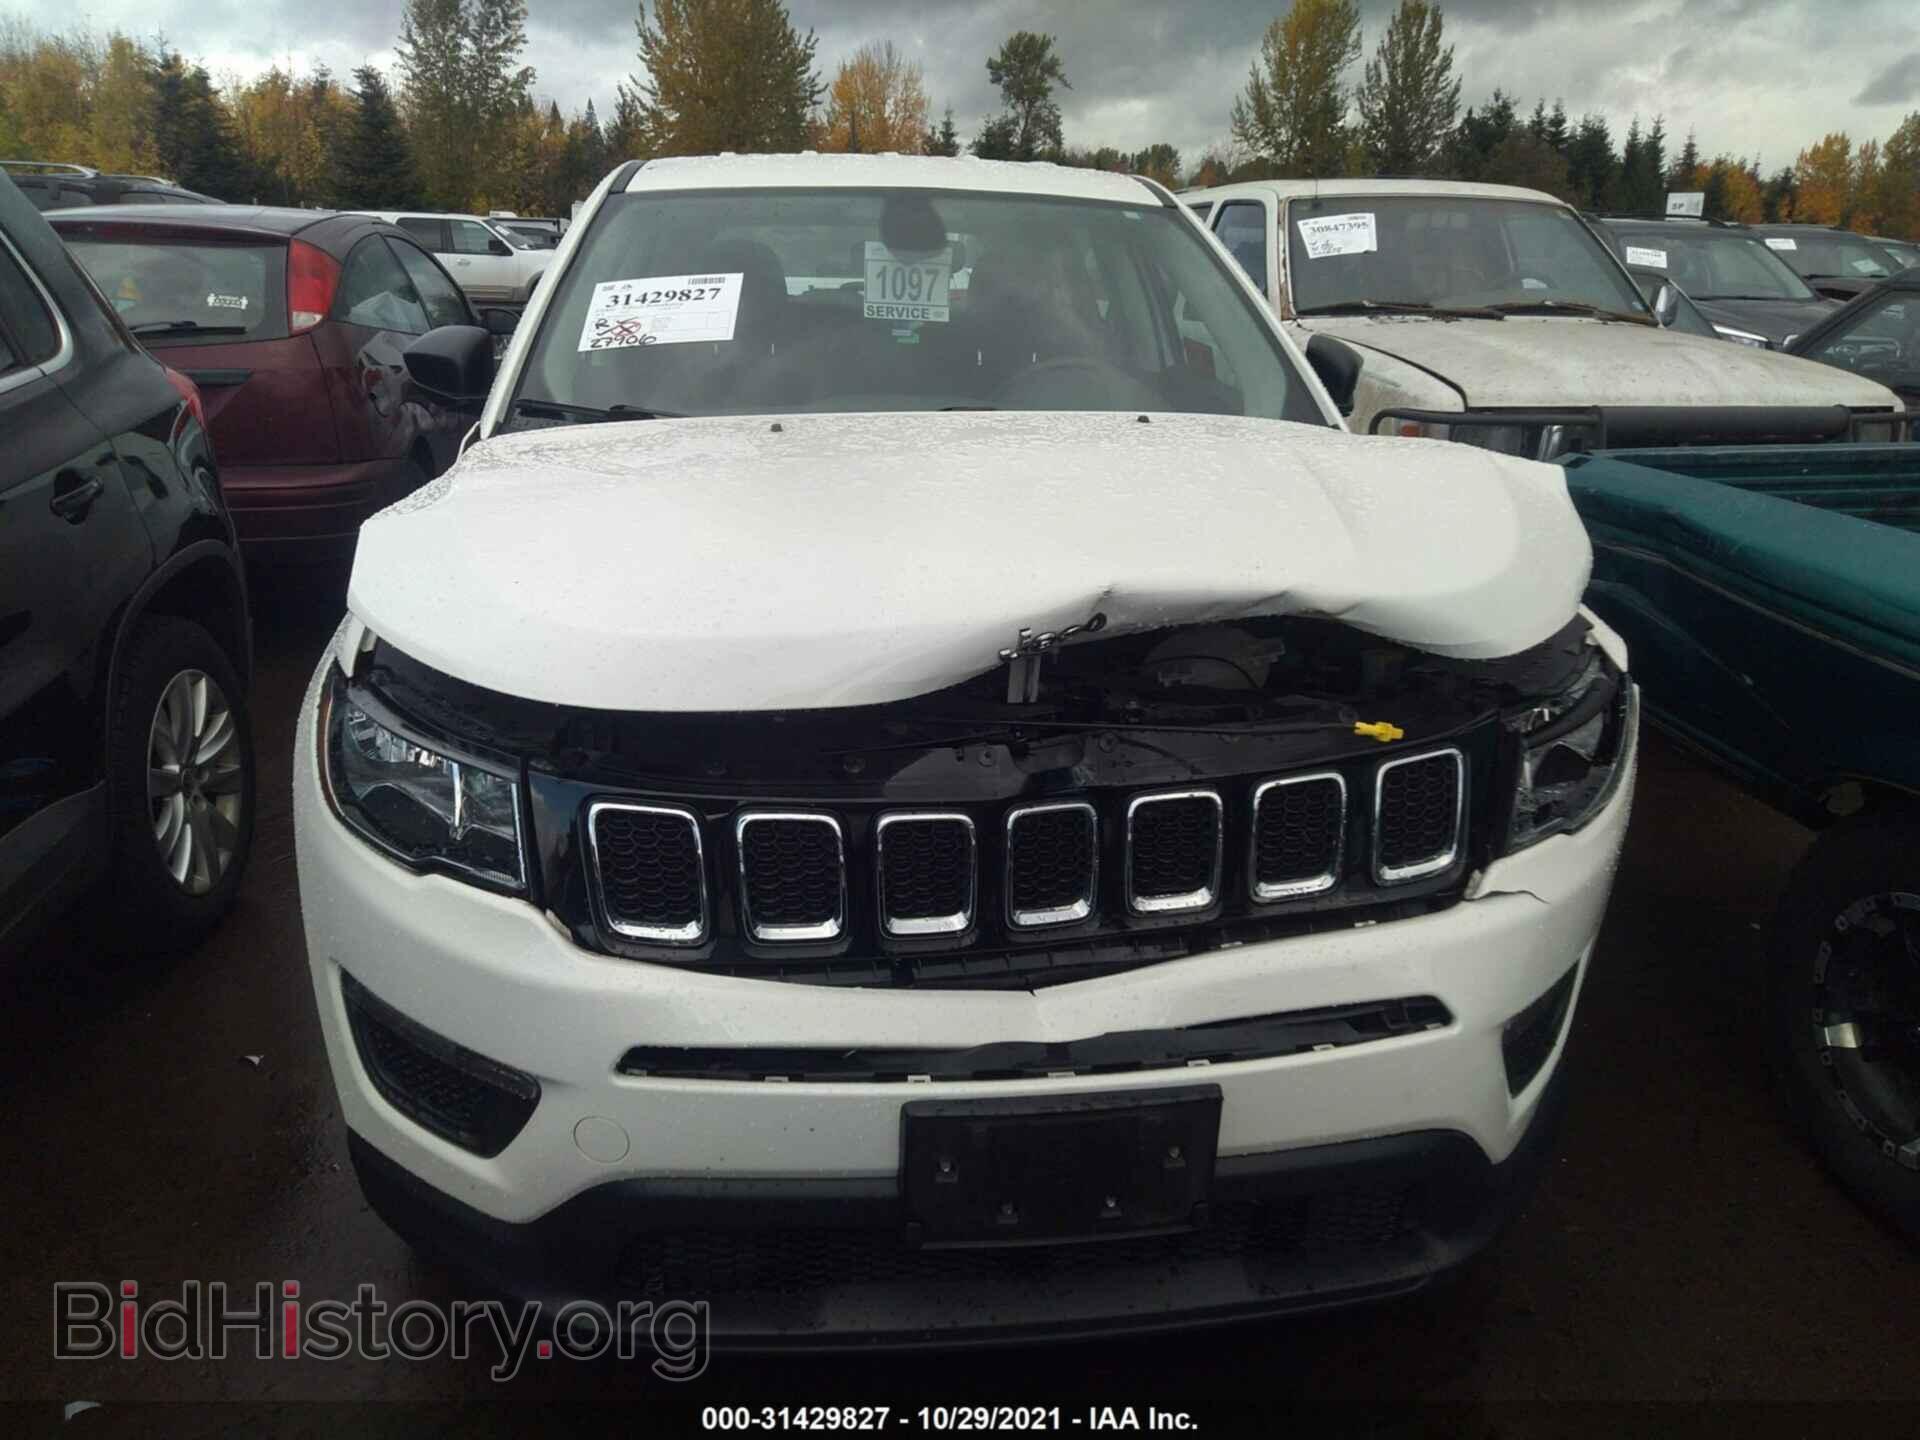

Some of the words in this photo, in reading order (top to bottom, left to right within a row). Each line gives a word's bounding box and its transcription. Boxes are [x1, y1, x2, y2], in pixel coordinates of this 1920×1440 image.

[876, 265, 940, 301] 1097
[605, 287, 721, 308] 31429827
[866, 304, 929, 319] SERVICE
